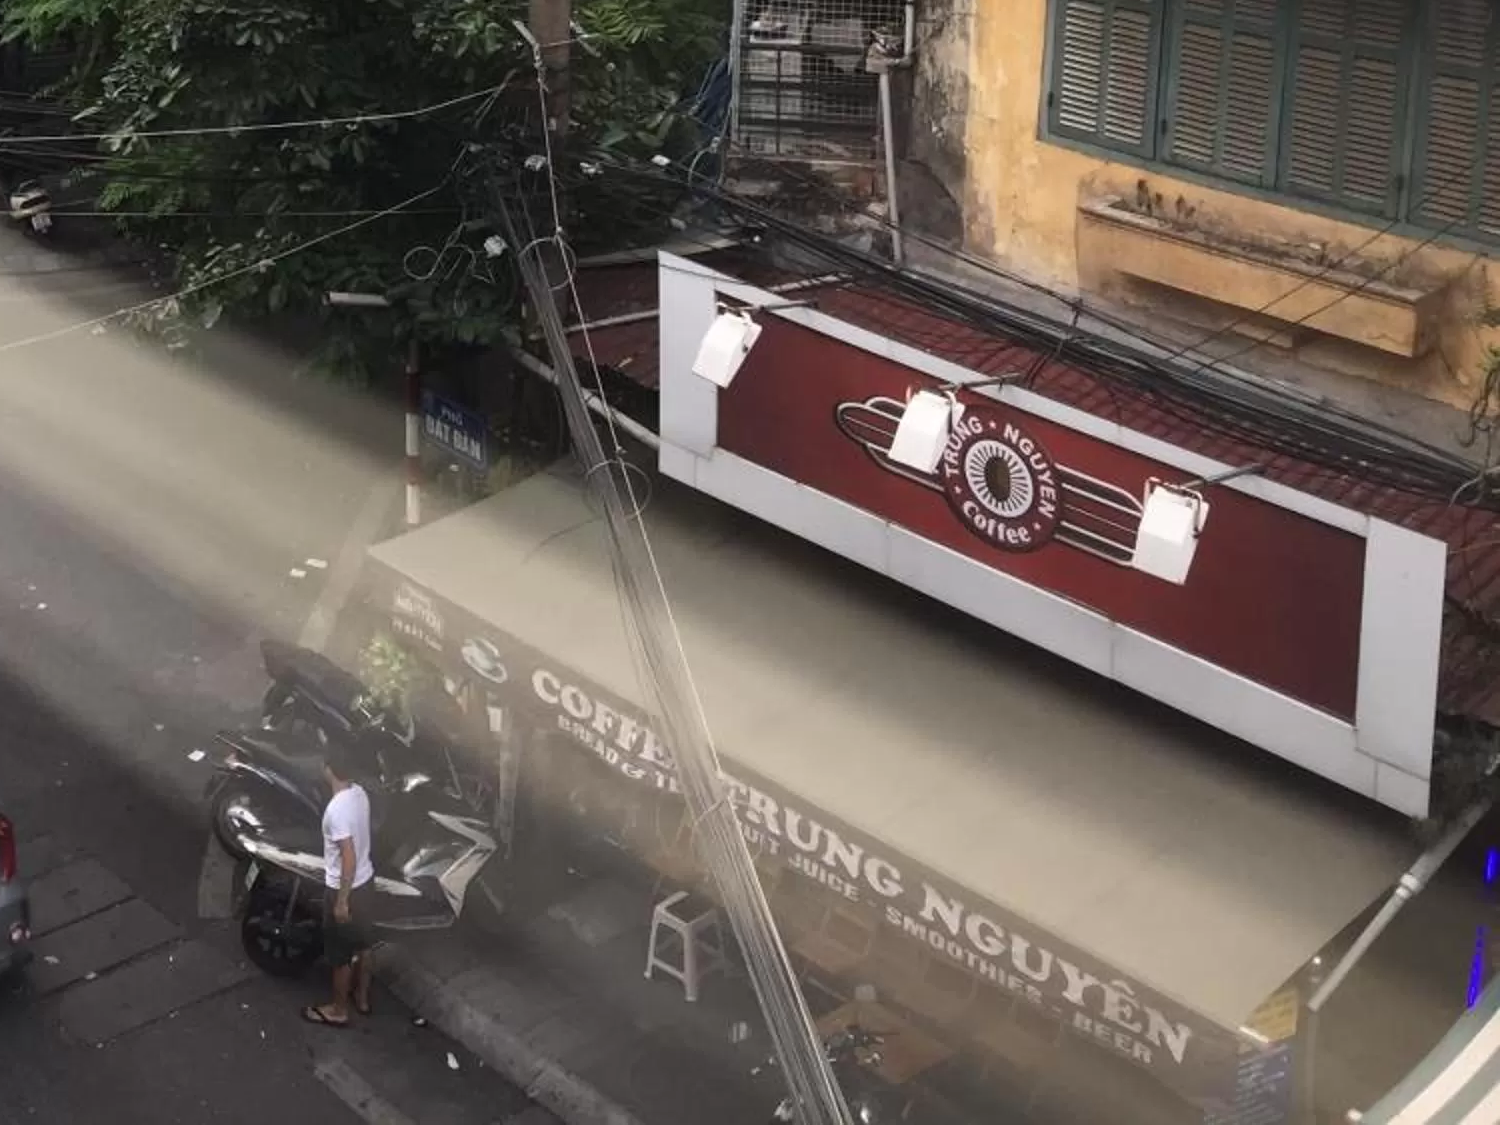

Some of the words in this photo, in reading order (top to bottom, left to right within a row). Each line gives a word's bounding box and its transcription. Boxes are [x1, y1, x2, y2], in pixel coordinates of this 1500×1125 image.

[945, 415, 984, 478] TRUNG
[962, 500, 1032, 545] Coffee
[788, 854, 861, 902] JUICE
[1072, 1010, 1152, 1064] BEER
[919, 883, 1193, 1064] NGUYÊN
